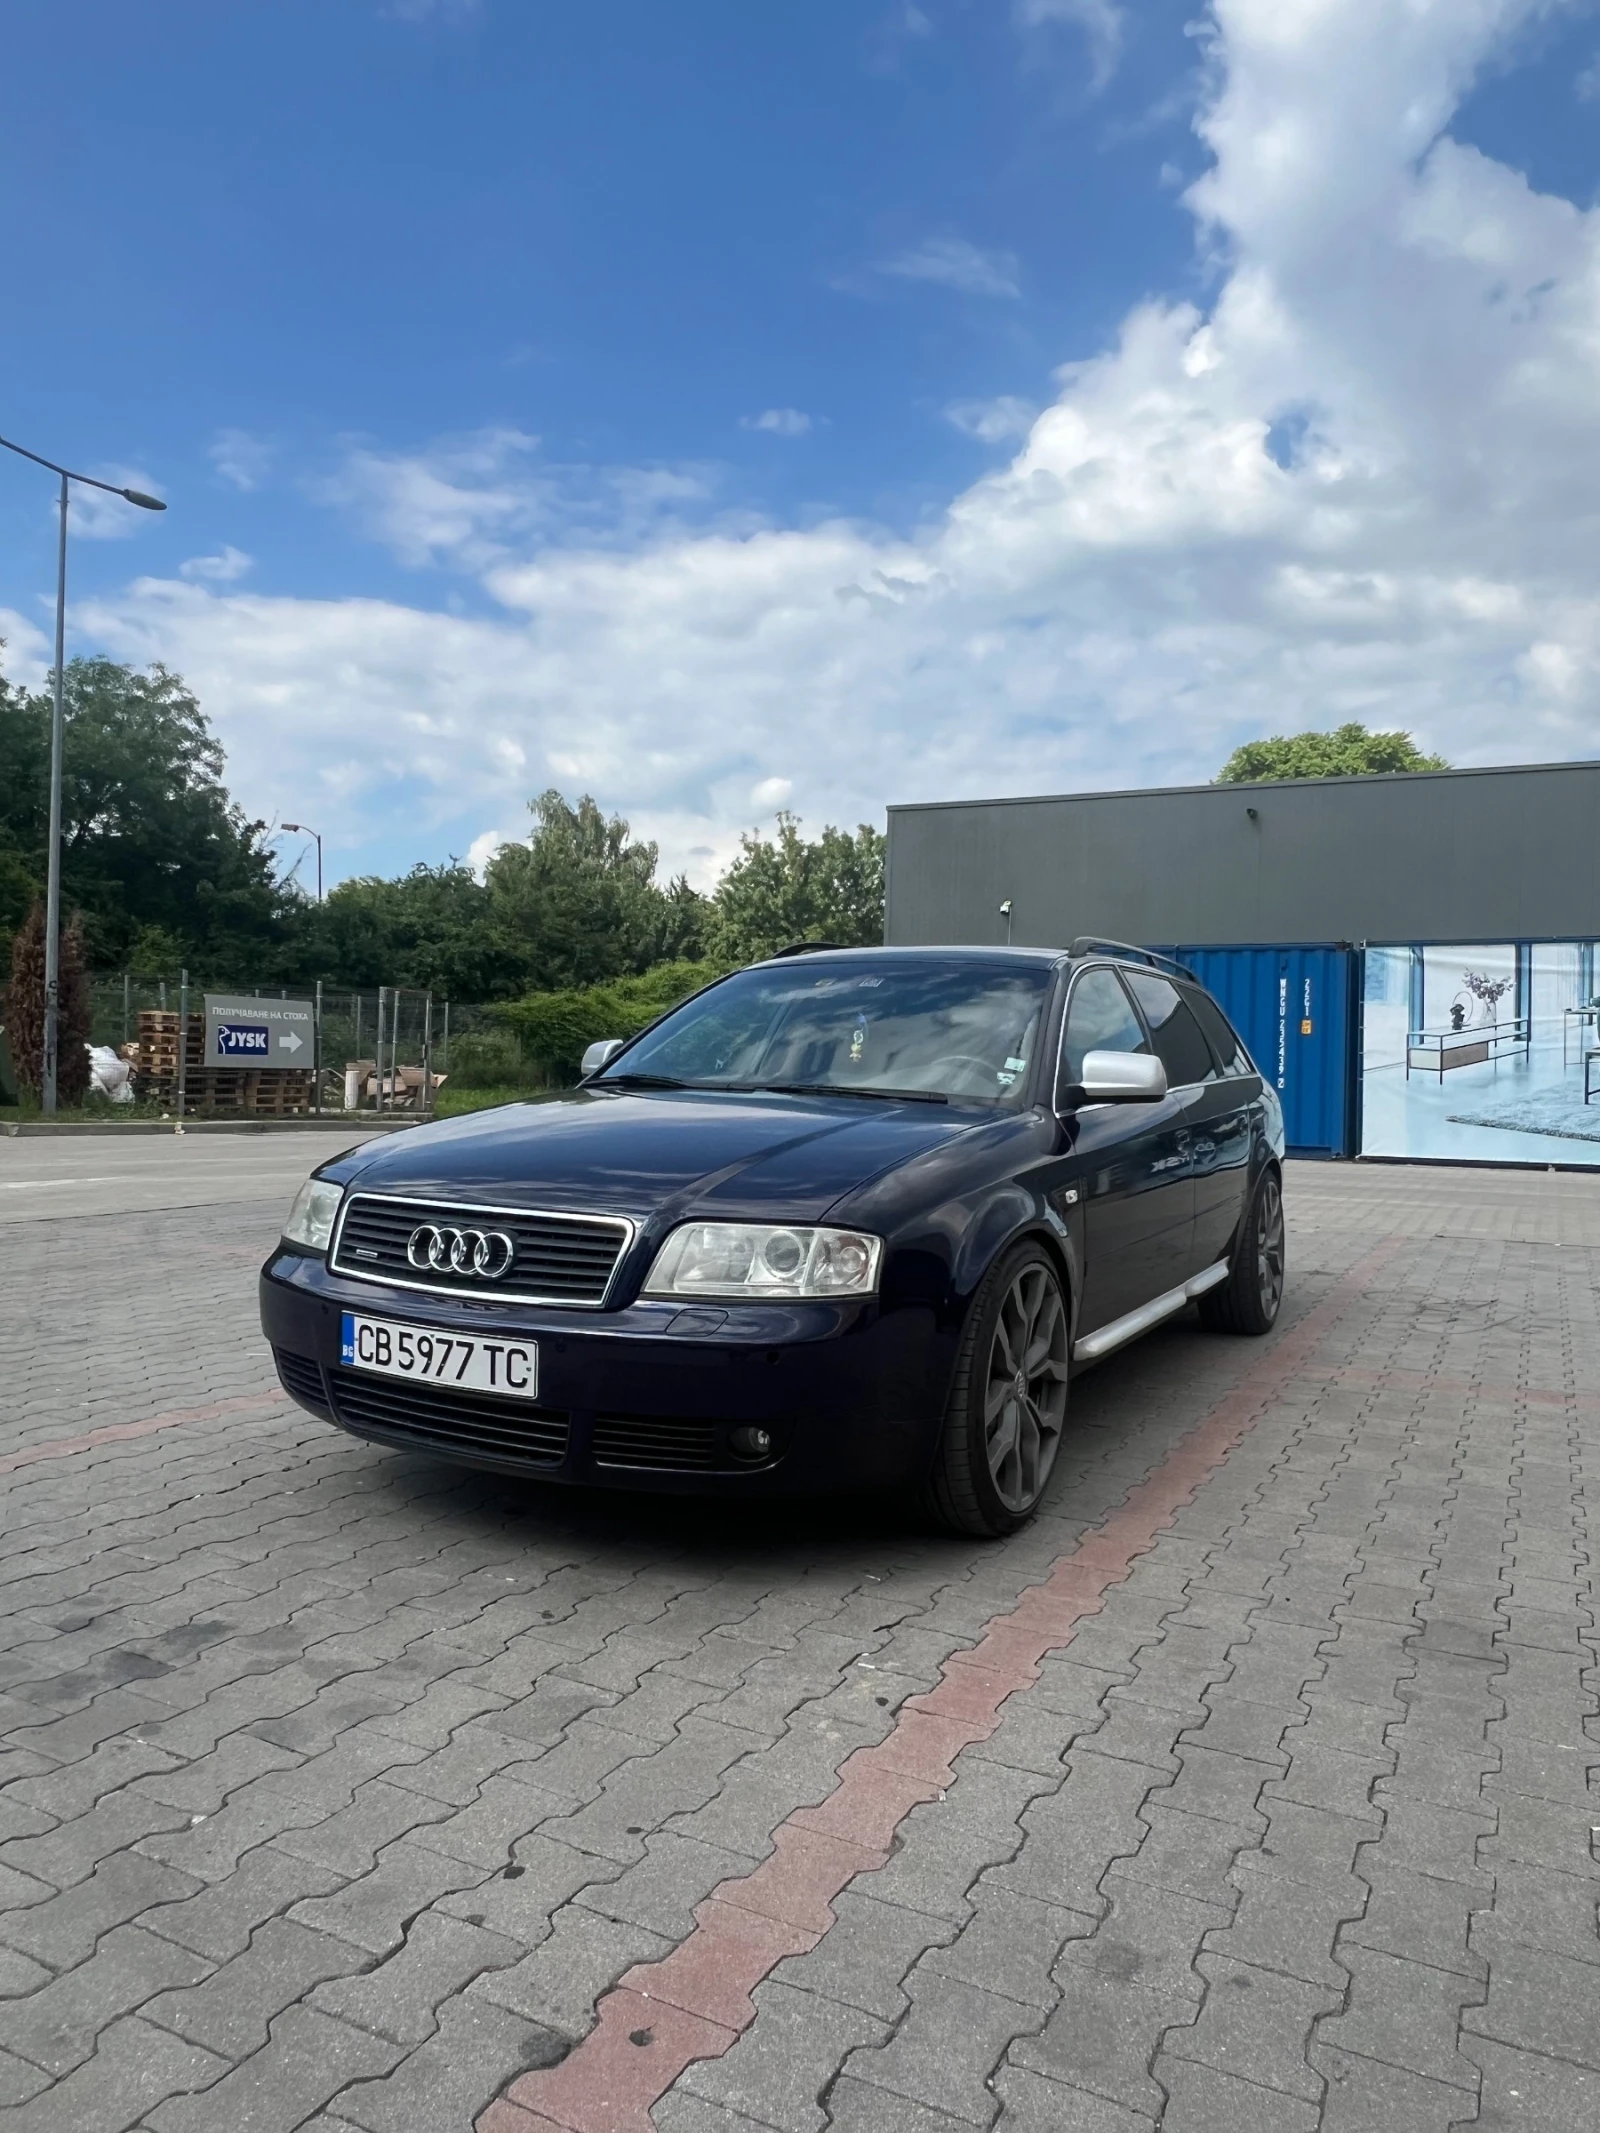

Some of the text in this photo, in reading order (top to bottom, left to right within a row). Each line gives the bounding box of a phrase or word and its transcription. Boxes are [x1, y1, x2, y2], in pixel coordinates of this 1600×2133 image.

[212, 1006, 269, 1019] ПОЛУЧАВАНЕ
[270, 1011, 282, 1020] НА
[228, 1032, 266, 1048] JYSK
[342, 1344, 354, 1358] BG
[398, 1331, 475, 1381] 5977
